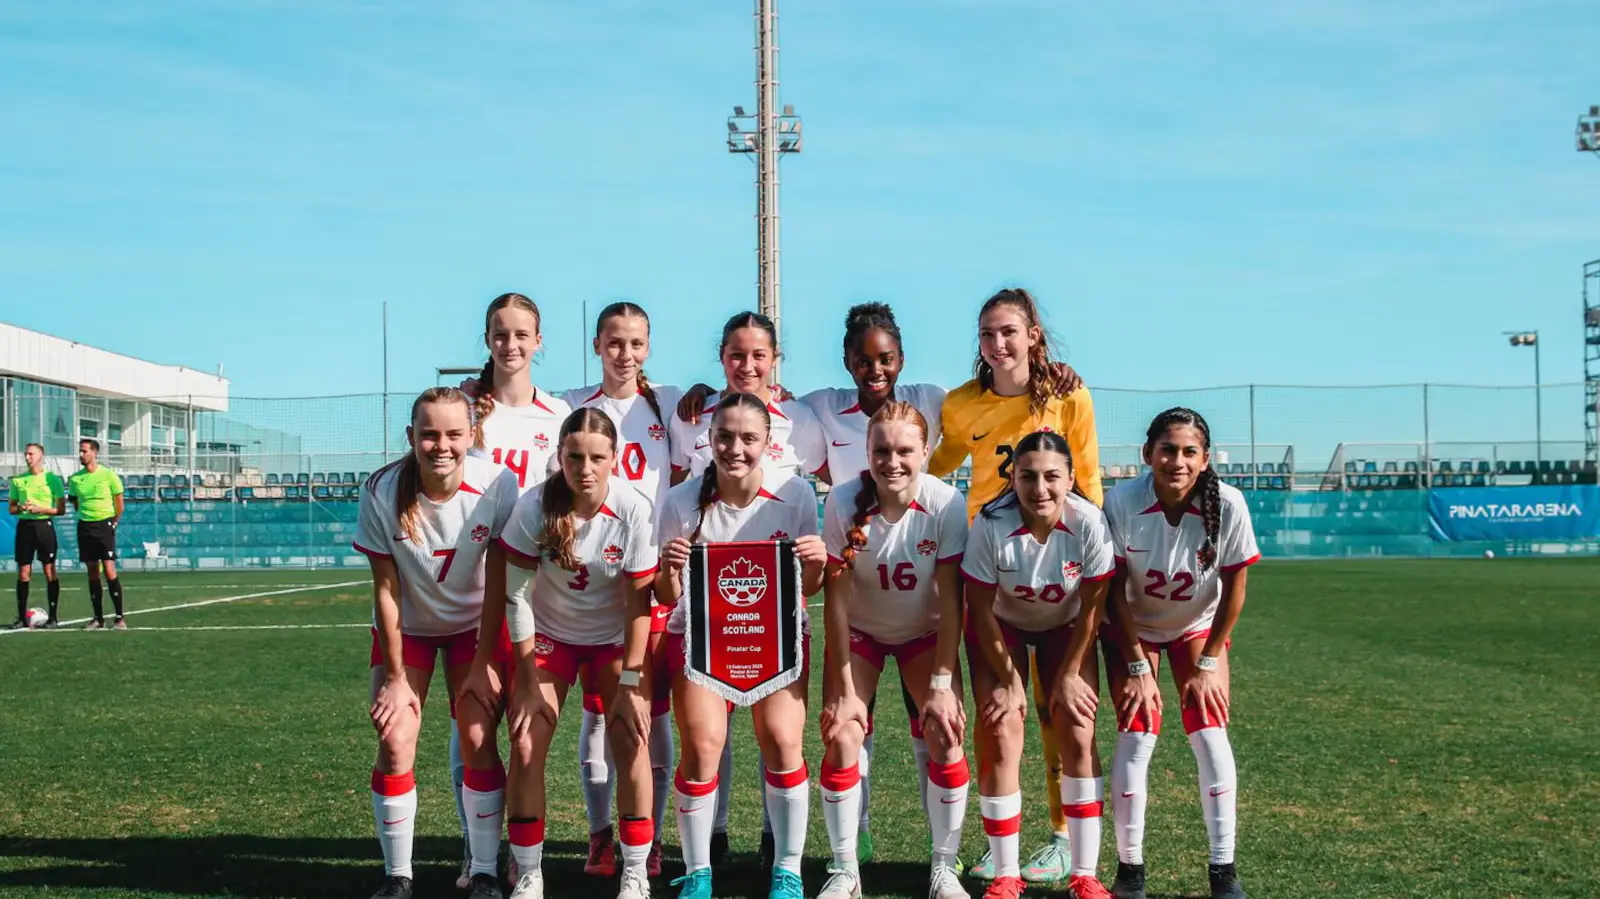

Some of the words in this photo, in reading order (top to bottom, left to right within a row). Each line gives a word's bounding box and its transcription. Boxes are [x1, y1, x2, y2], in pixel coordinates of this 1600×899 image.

[492, 448, 529, 488] 14
[611, 443, 647, 480] 0
[432, 549, 457, 583] 7
[567, 565, 590, 591] 3
[877, 562, 918, 591] 16
[1013, 584, 1066, 604] 20
[1144, 569, 1194, 601] 22
[722, 625, 765, 634] SCOTLAND
[727, 613, 760, 621] CANADA
